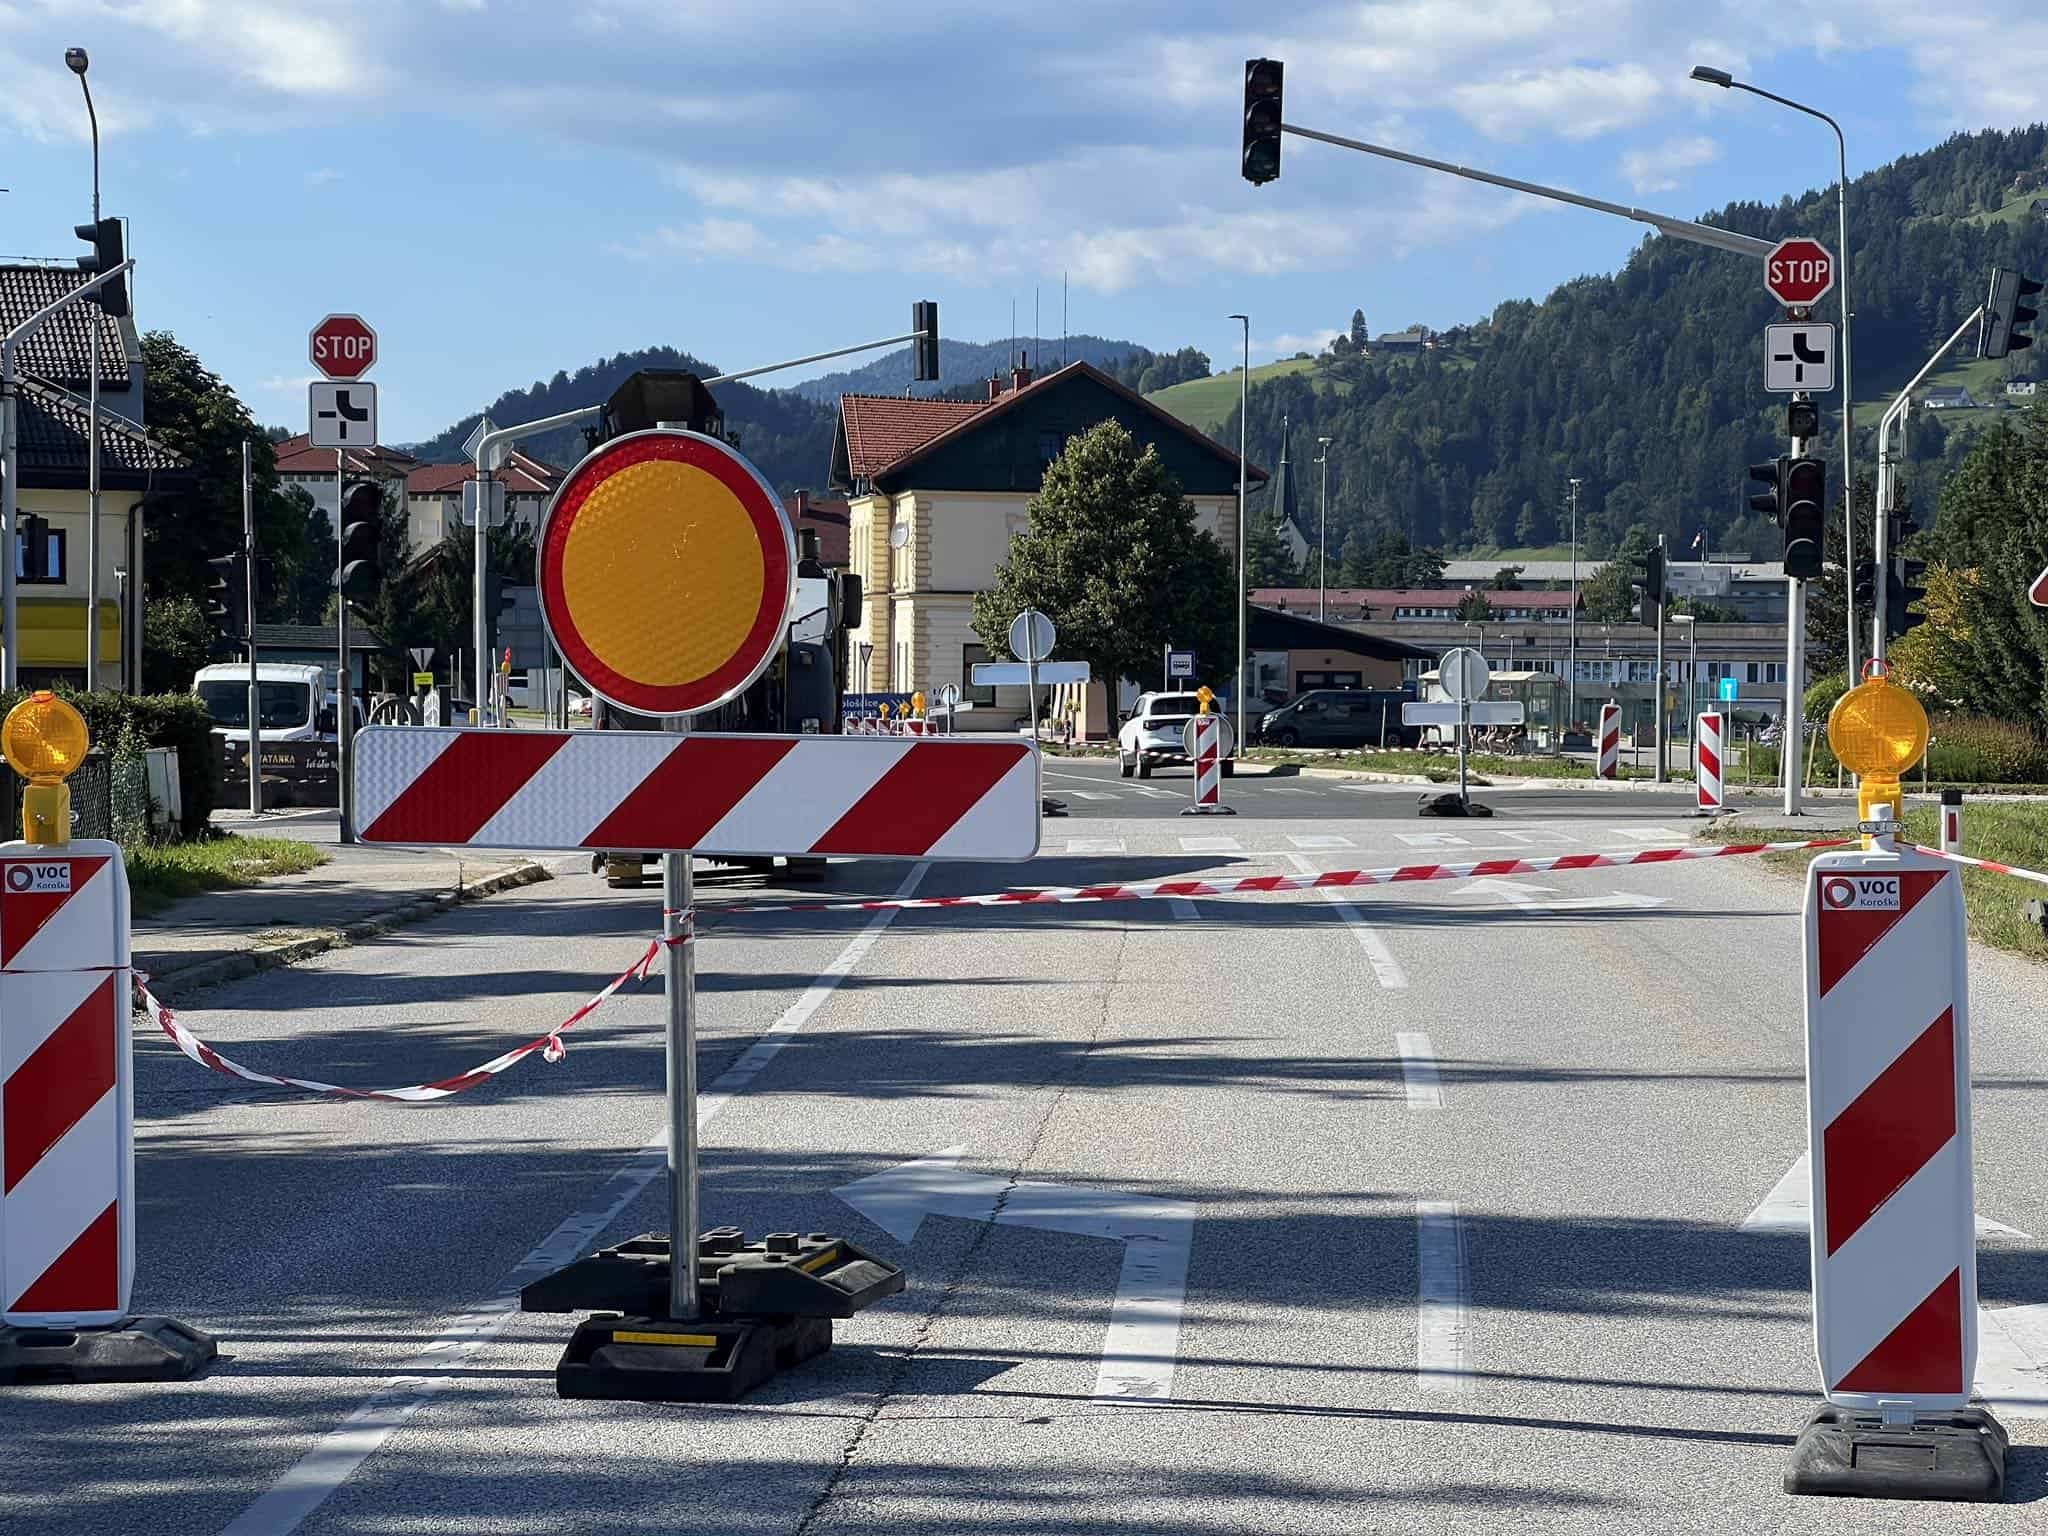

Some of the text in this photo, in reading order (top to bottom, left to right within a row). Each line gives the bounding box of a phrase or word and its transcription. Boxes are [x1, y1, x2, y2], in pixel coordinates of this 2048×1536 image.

[1770, 260, 1828, 284] STOP
[315, 335, 371, 359] STOP
[36, 866, 68, 879] VOC
[1859, 880, 1897, 895] VOC
